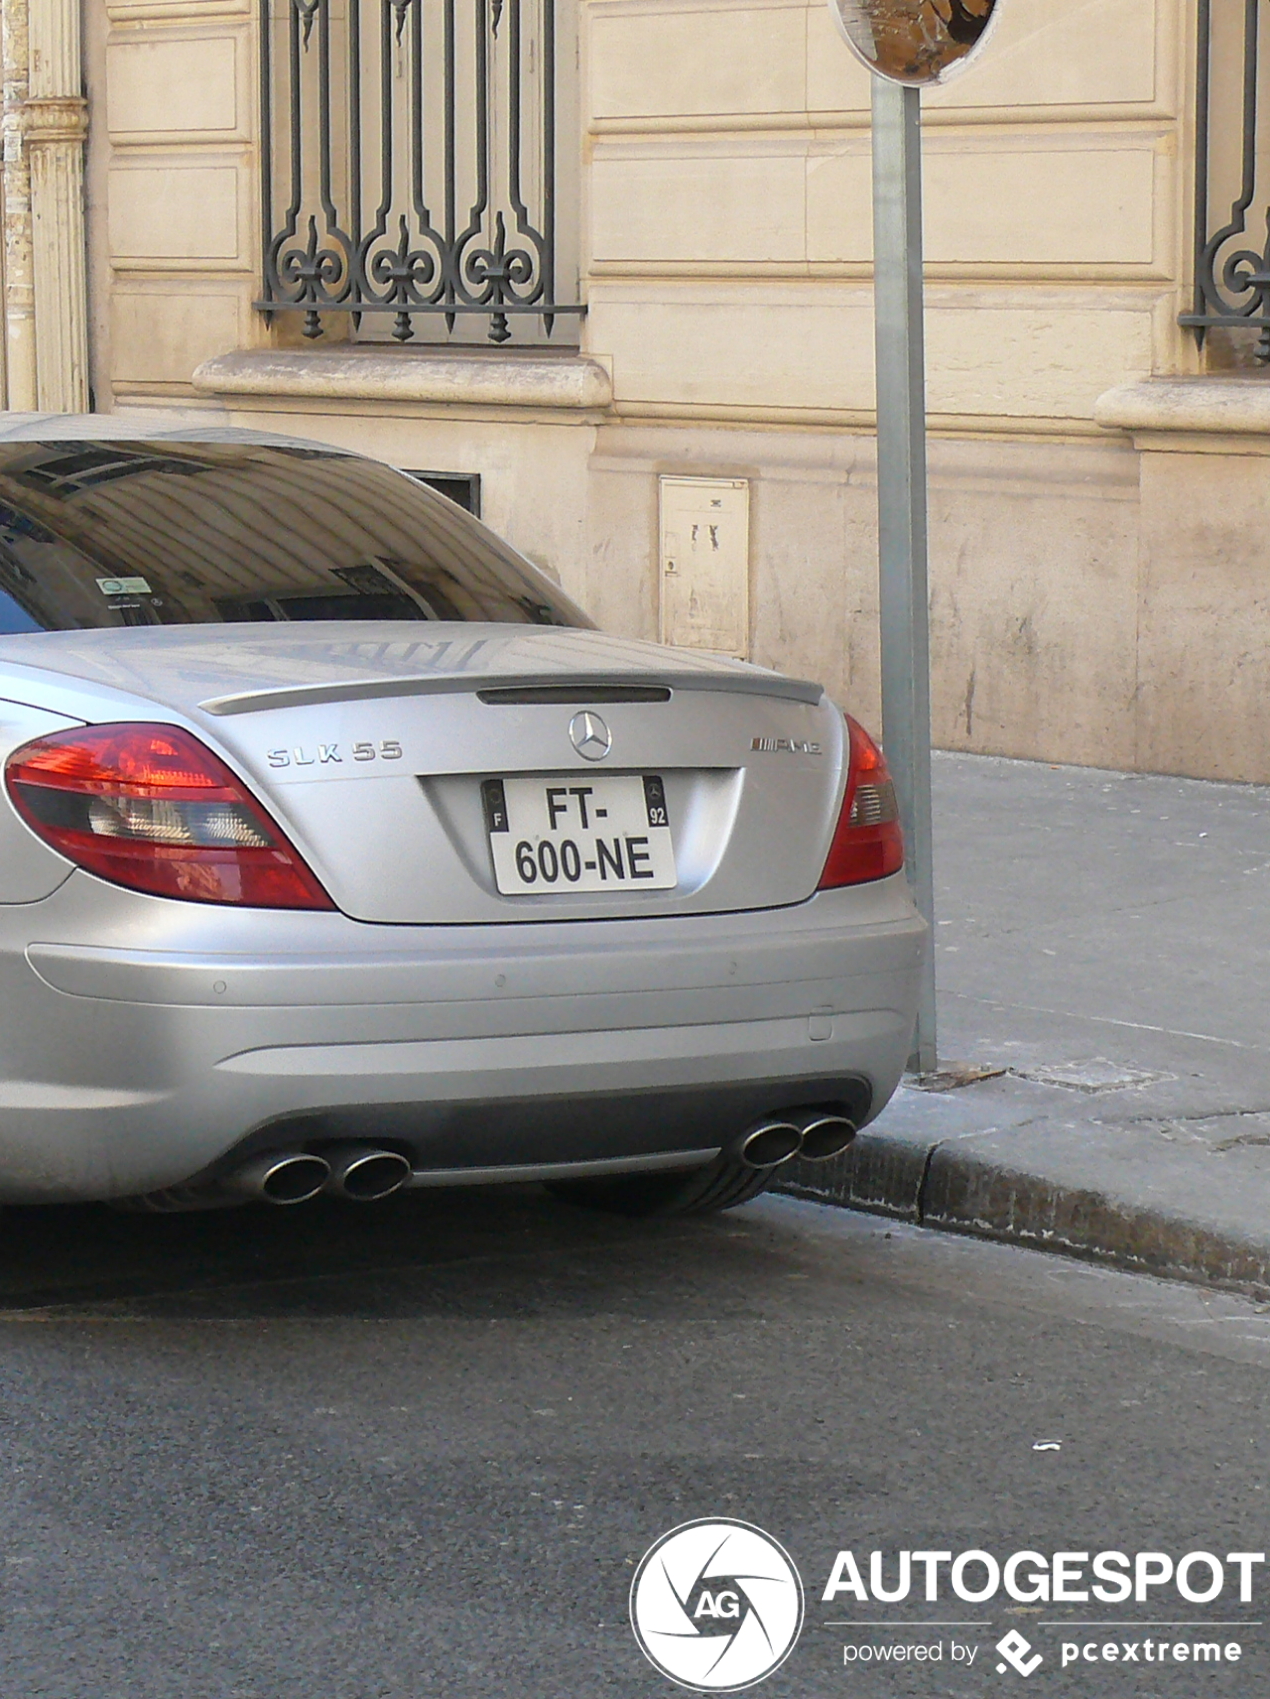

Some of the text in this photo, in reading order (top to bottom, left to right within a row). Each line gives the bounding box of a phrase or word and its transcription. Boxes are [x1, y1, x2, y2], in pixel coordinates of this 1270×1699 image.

[267, 740, 403, 768] SLK 55
[493, 813, 502, 827] F
[546, 787, 608, 830] FT-
[649, 807, 666, 825] 92
[515, 836, 655, 884] 600-NE
